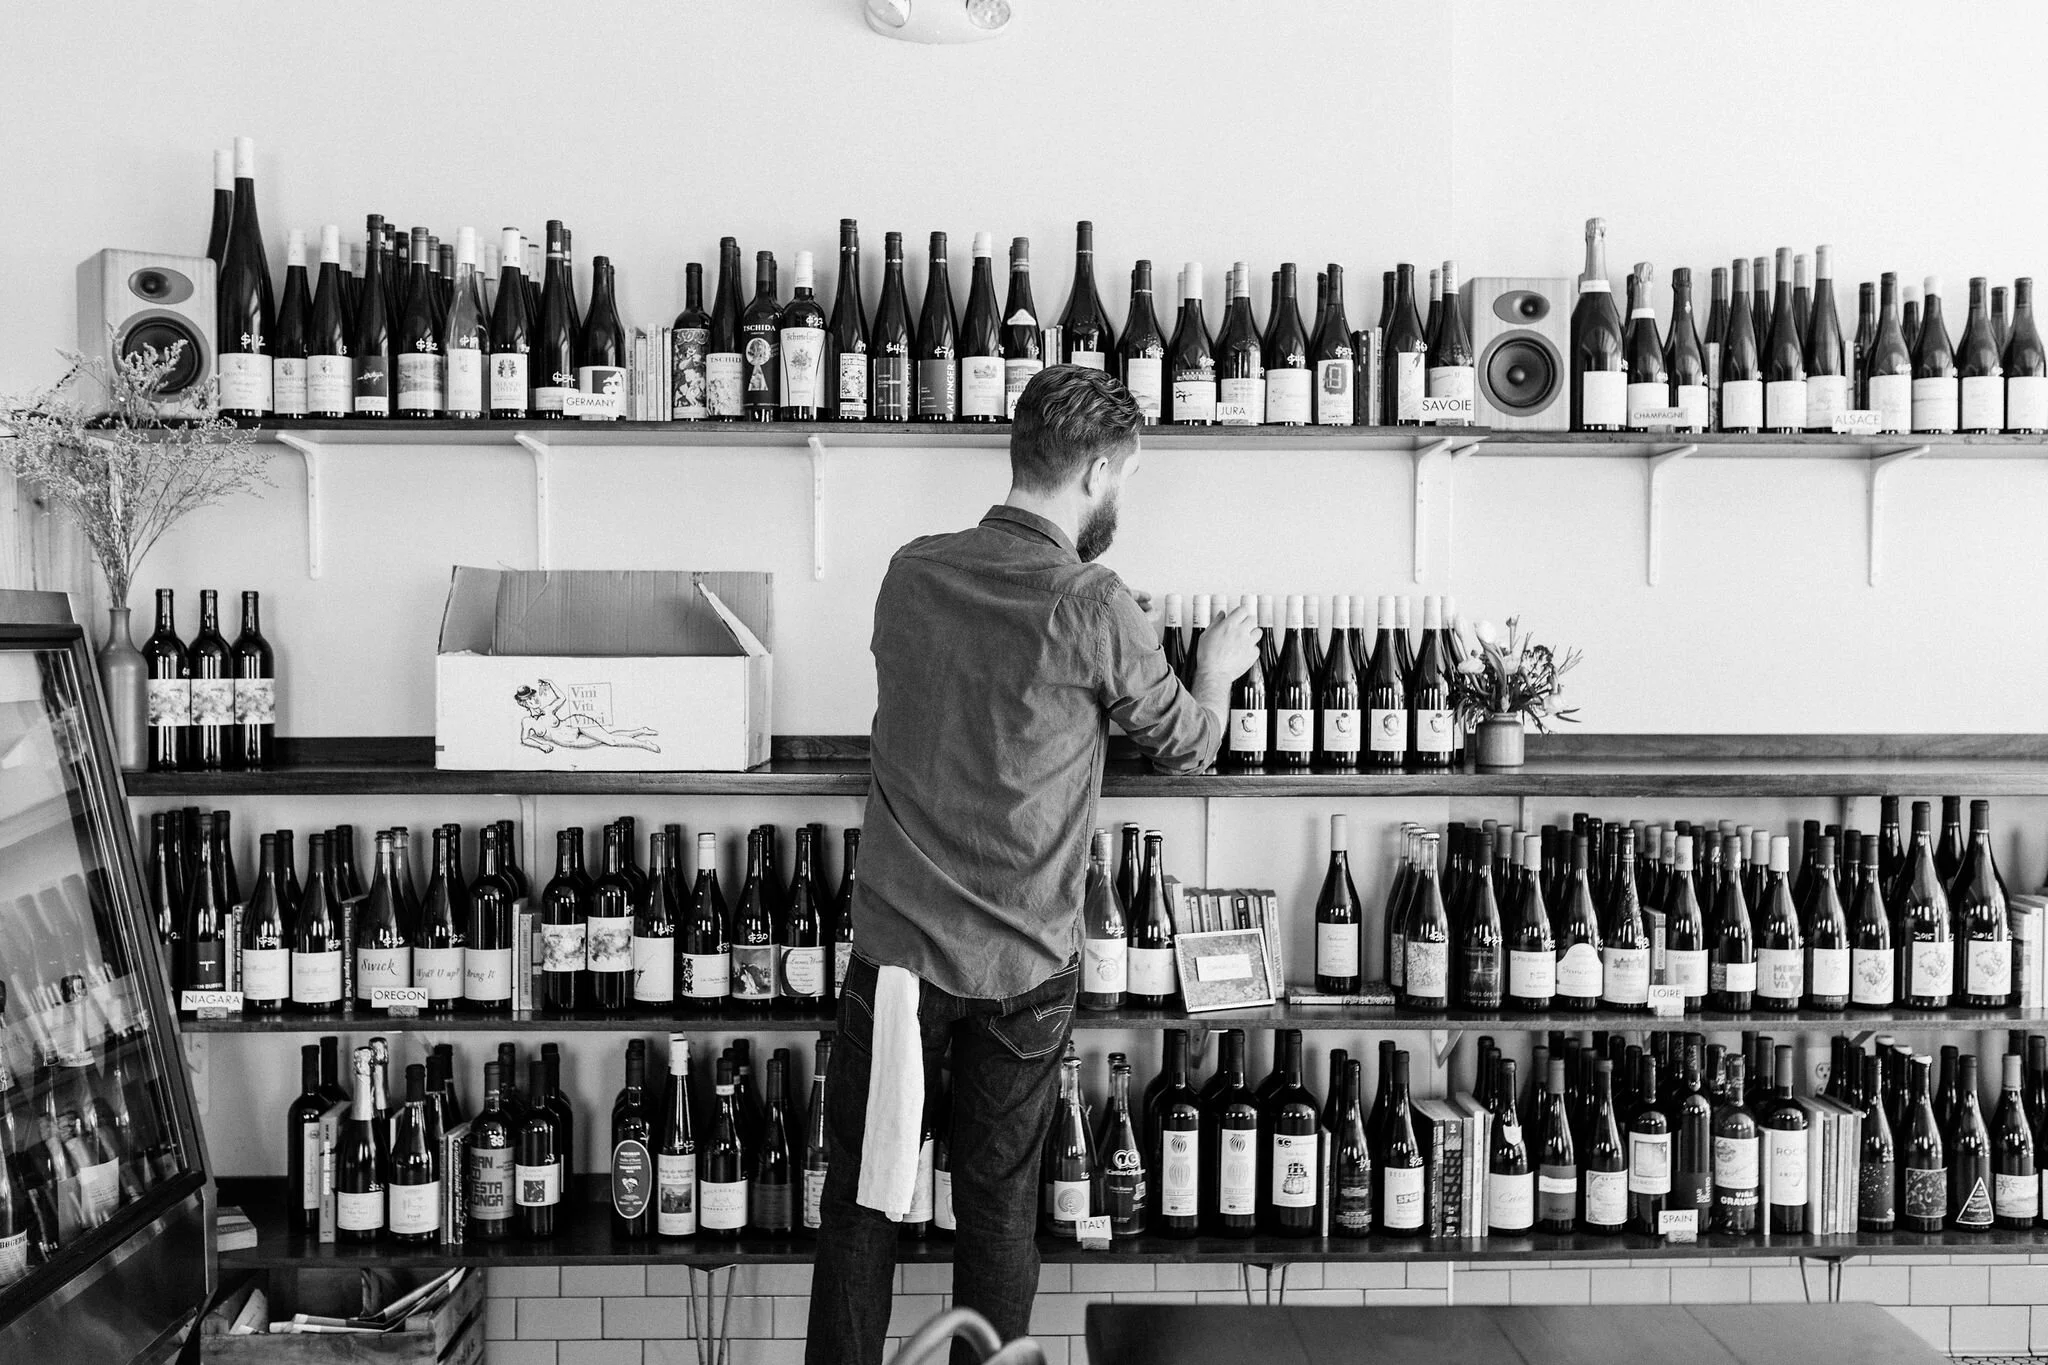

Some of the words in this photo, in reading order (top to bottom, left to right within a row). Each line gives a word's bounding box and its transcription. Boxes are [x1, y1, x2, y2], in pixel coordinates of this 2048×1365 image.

[946, 363, 955, 411] ALZINGER
[565, 398, 615, 409] GERMANY
[1421, 399, 1471, 412] SAVOIE
[1220, 406, 1246, 416] JURA
[1633, 412, 1684, 421] CHAMPAGNE
[1836, 416, 1880, 426] ALSACE
[571, 687, 597, 698] Vini
[748, 931, 769, 944] $30
[361, 958, 397, 976] Swick
[374, 991, 425, 1001] OREGON
[1653, 989, 1680, 998] LOIRE
[185, 995, 240, 1004] NIAGARA
[1079, 1219, 1105, 1230] ITALY
[1661, 1215, 1692, 1224] SPAIN
